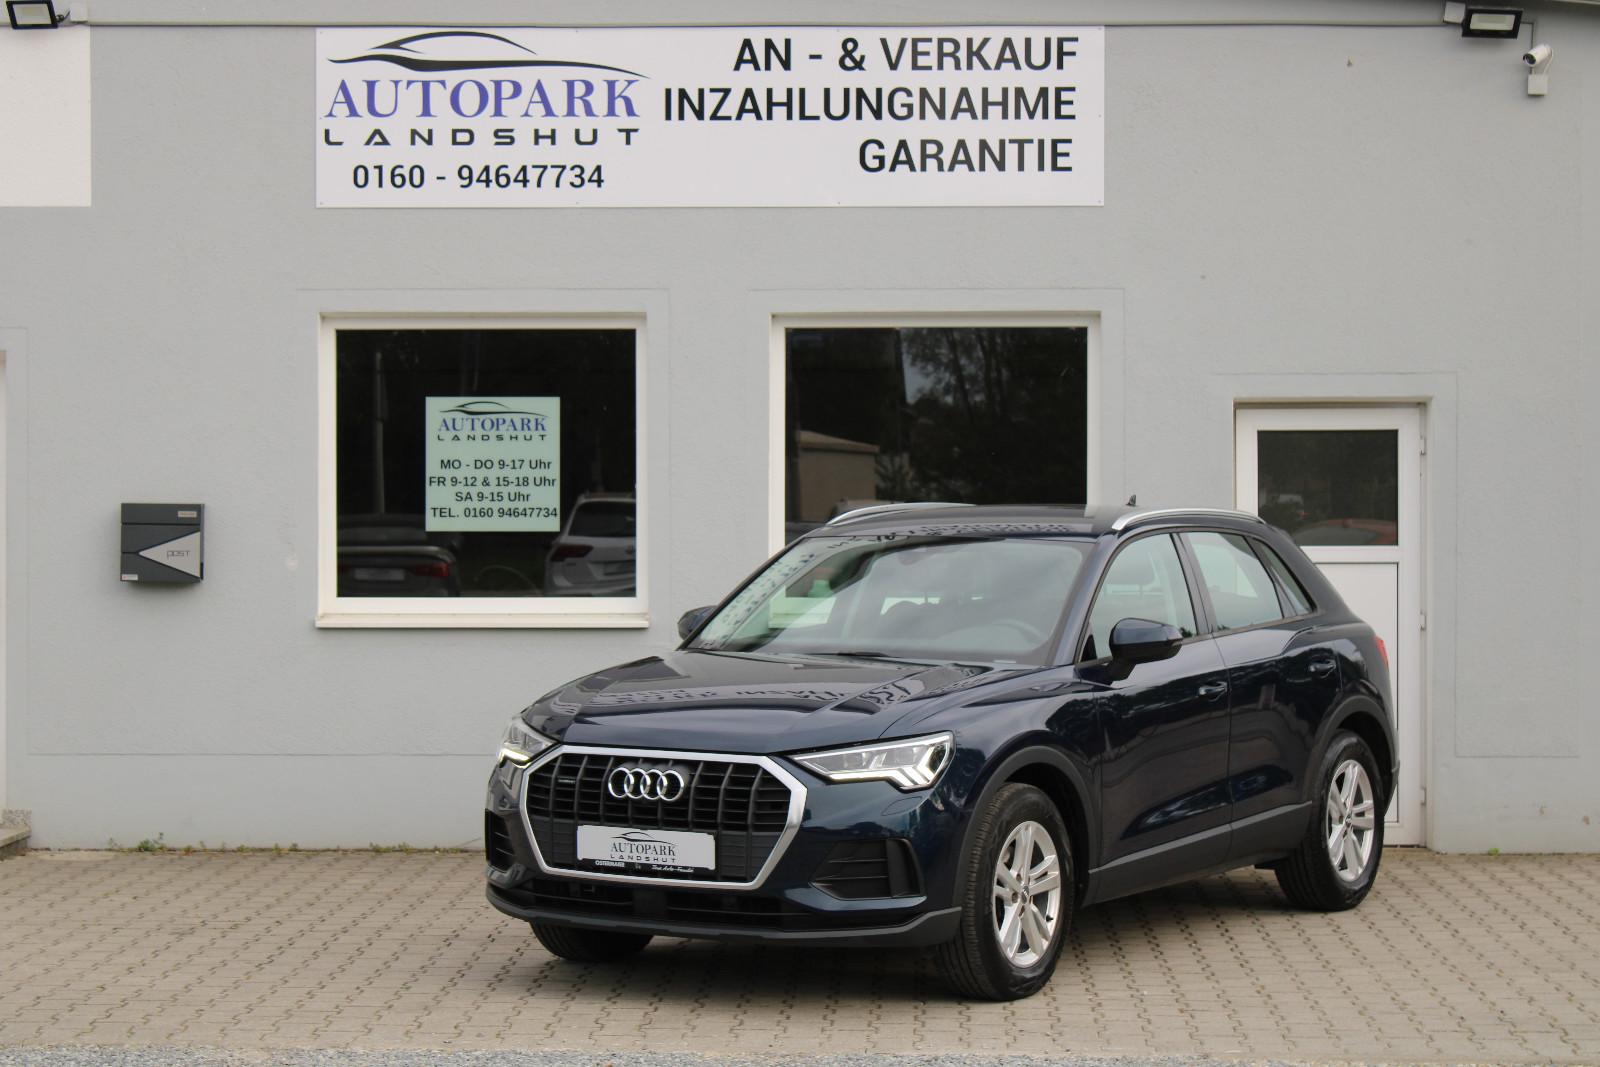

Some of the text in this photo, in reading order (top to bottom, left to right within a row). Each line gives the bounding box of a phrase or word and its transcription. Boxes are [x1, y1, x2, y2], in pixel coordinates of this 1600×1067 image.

[733, 38, 792, 71] AN
[838, 37, 866, 71] &
[880, 36, 1079, 71] VERKAUF
[324, 78, 640, 118] AUTOPARK
[664, 86, 1077, 121] INZAHLUNGNAHME
[324, 128, 640, 146] LANDSHUT
[859, 138, 1073, 173] GARANTIE
[352, 164, 425, 188] 0160
[457, 164, 605, 188] 94647734
[438, 417, 547, 432] AUTOPARK
[440, 459, 462, 470] MO
[474, 459, 494, 470] DO
[498, 459, 525, 470] 9-17
[529, 459, 552, 470] Uhr
[429, 476, 557, 487] FR 9-12 & 15-18 Uhr
[455, 491, 531, 502] SA 9-15 Uhr
[431, 507, 558, 518] TEL. 0160 94647734
[610, 842, 676, 857] AUTOPARK
[610, 855, 676, 863] LANDSHUT
